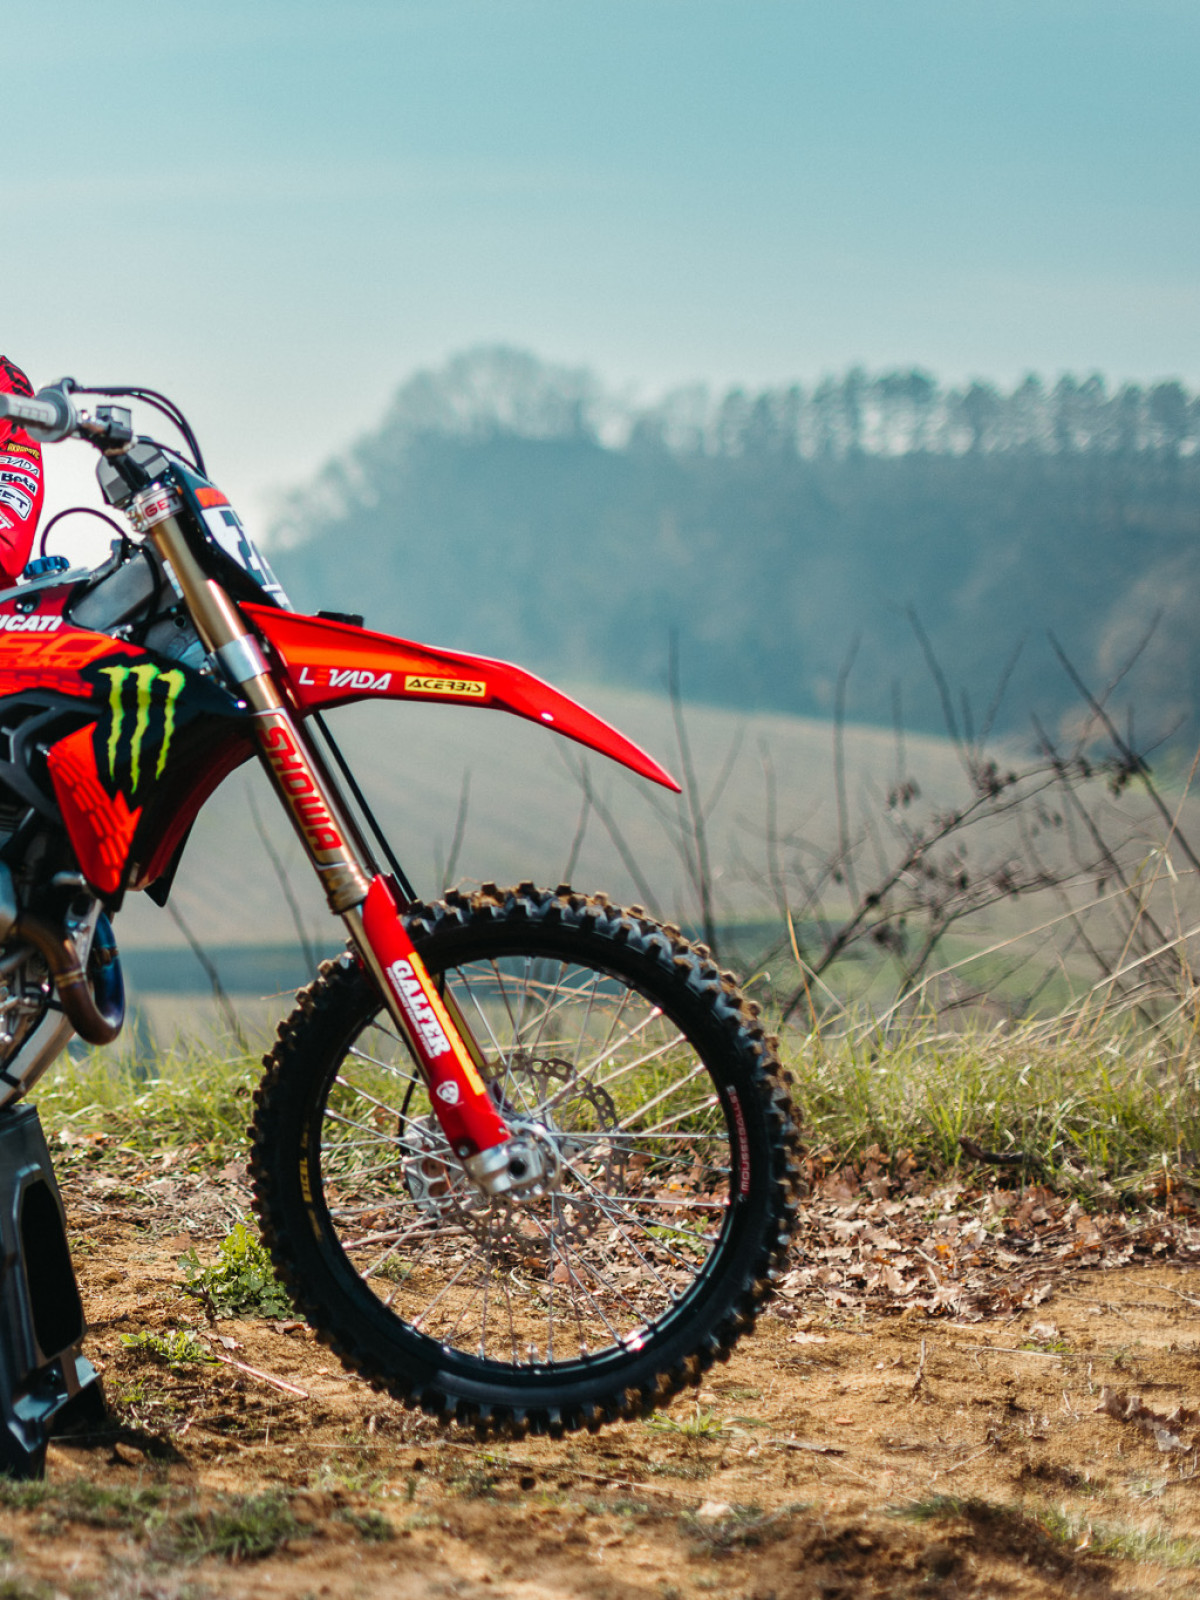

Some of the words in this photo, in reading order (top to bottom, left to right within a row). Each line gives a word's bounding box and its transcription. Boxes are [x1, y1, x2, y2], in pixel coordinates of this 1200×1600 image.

[142, 494, 179, 518] GET
[407, 678, 483, 693] ACERBIS
[258, 726, 344, 852] SHOWA
[392, 959, 451, 1057] GALFER
